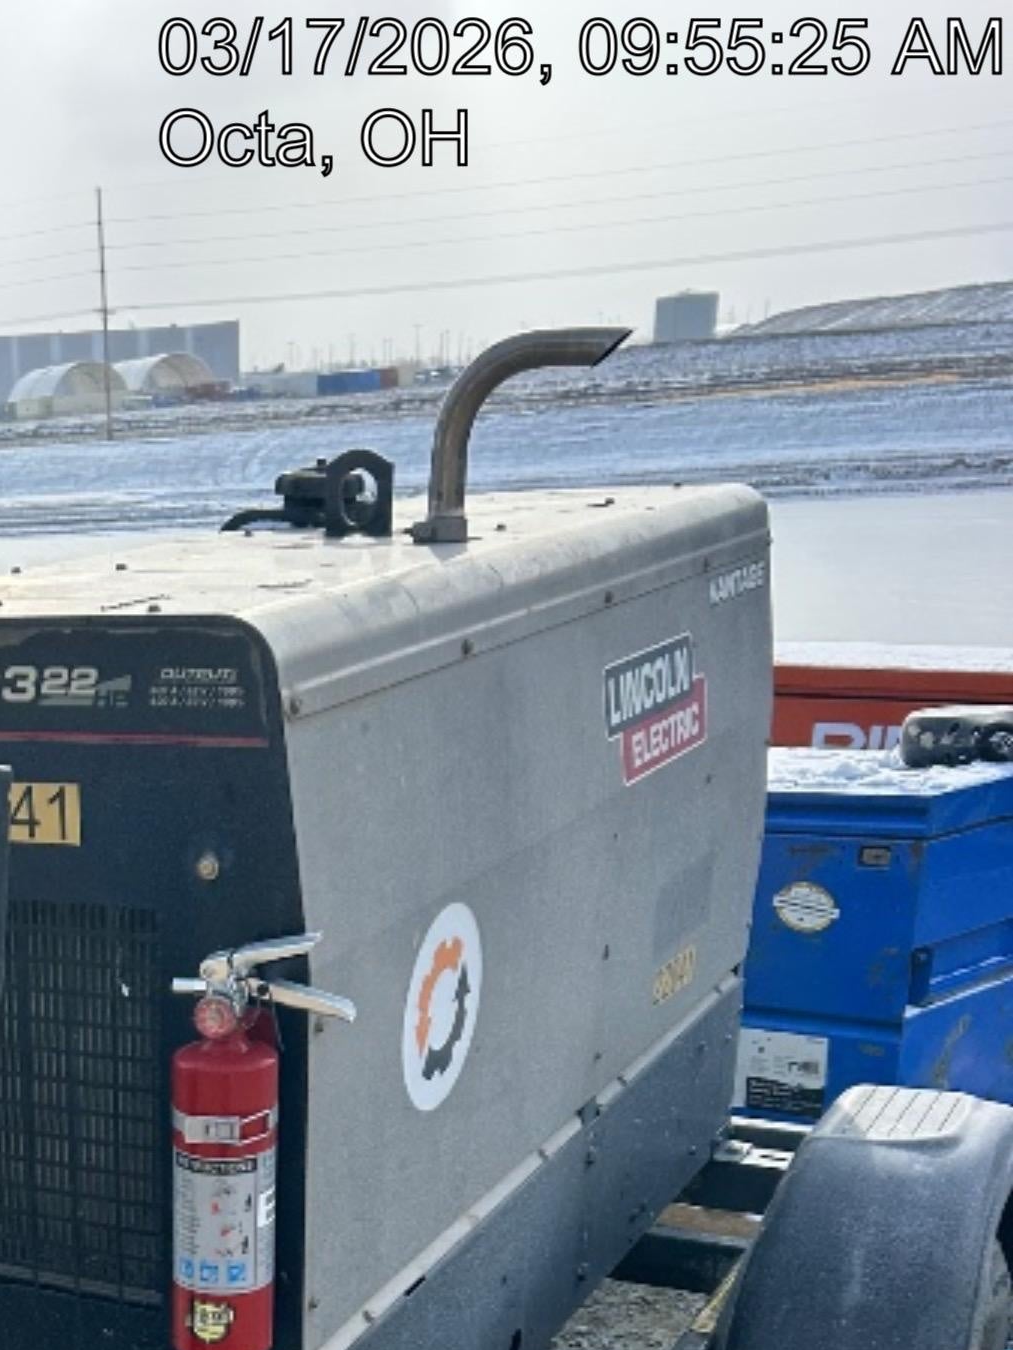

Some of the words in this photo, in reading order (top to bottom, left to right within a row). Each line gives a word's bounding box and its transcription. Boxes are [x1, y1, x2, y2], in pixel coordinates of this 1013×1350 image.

[1, 664, 100, 703] 322
[608, 646, 691, 727] LINCOLN
[631, 702, 700, 768] ELECTRIC
